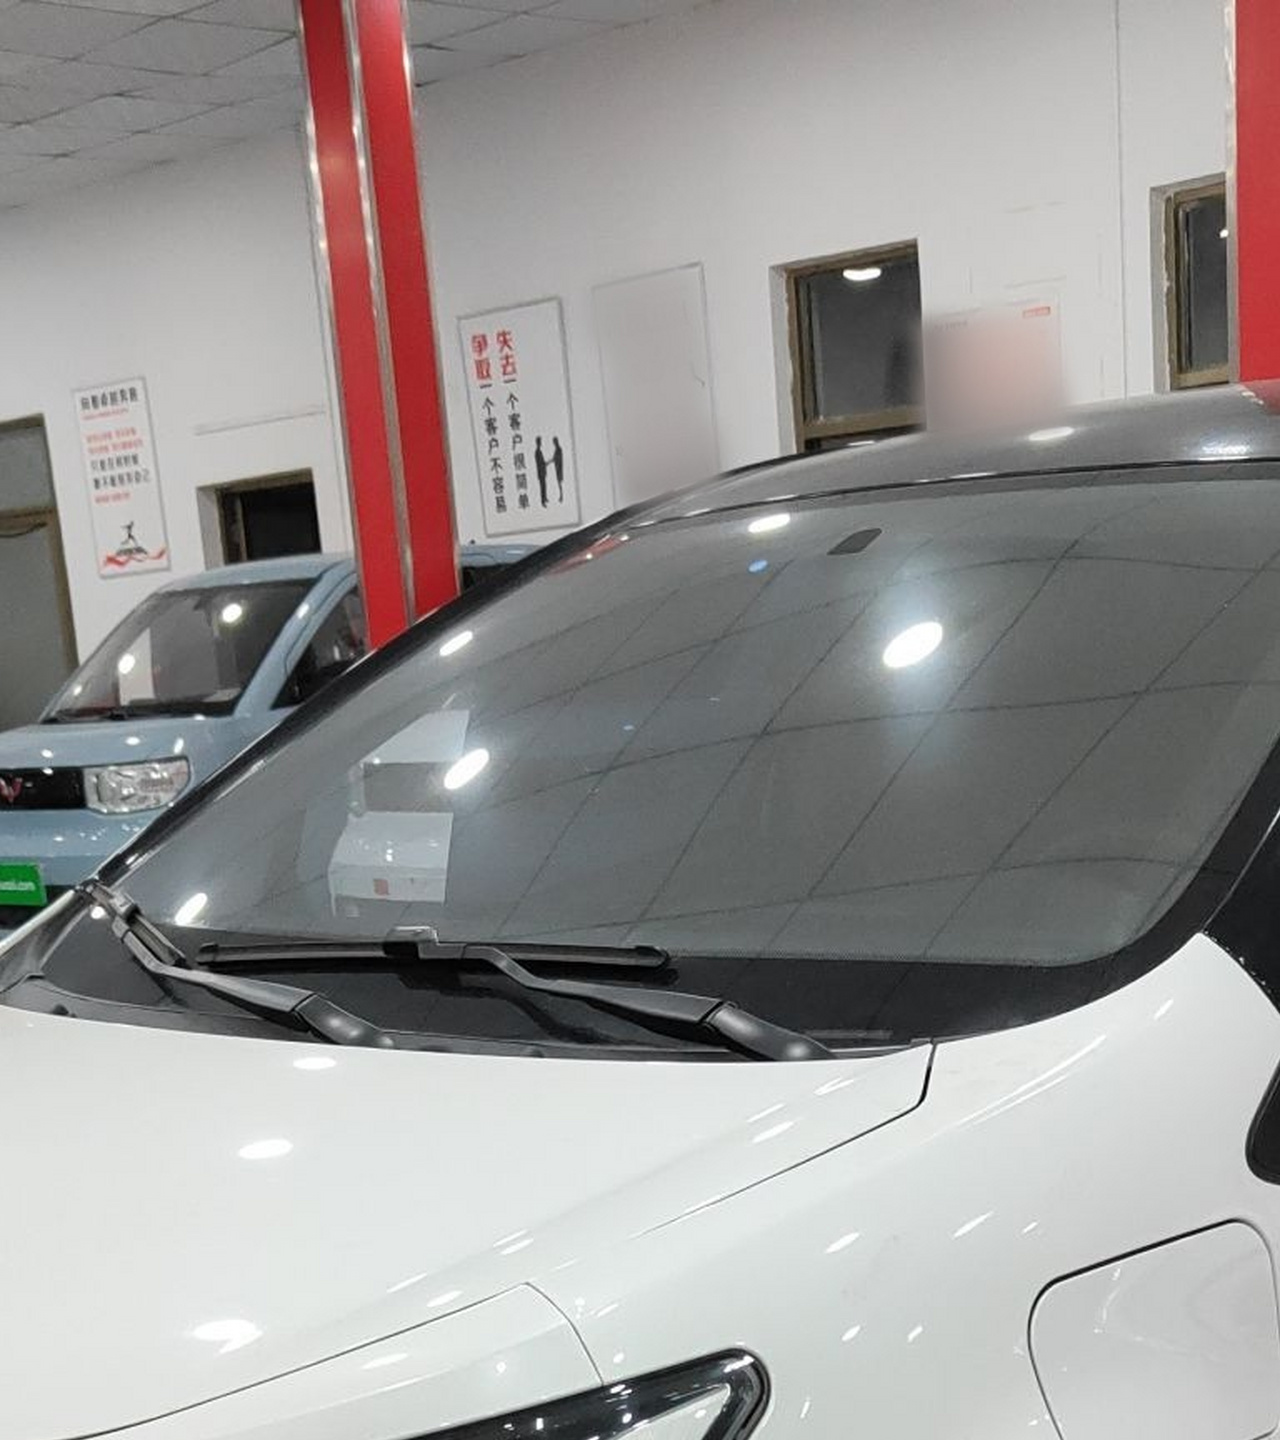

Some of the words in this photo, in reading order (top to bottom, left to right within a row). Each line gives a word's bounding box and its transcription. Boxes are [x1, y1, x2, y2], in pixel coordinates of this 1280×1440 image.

[472, 333, 507, 514] 争取一个客户不容易
[496, 329, 530, 510] 失去一个客户很简单
